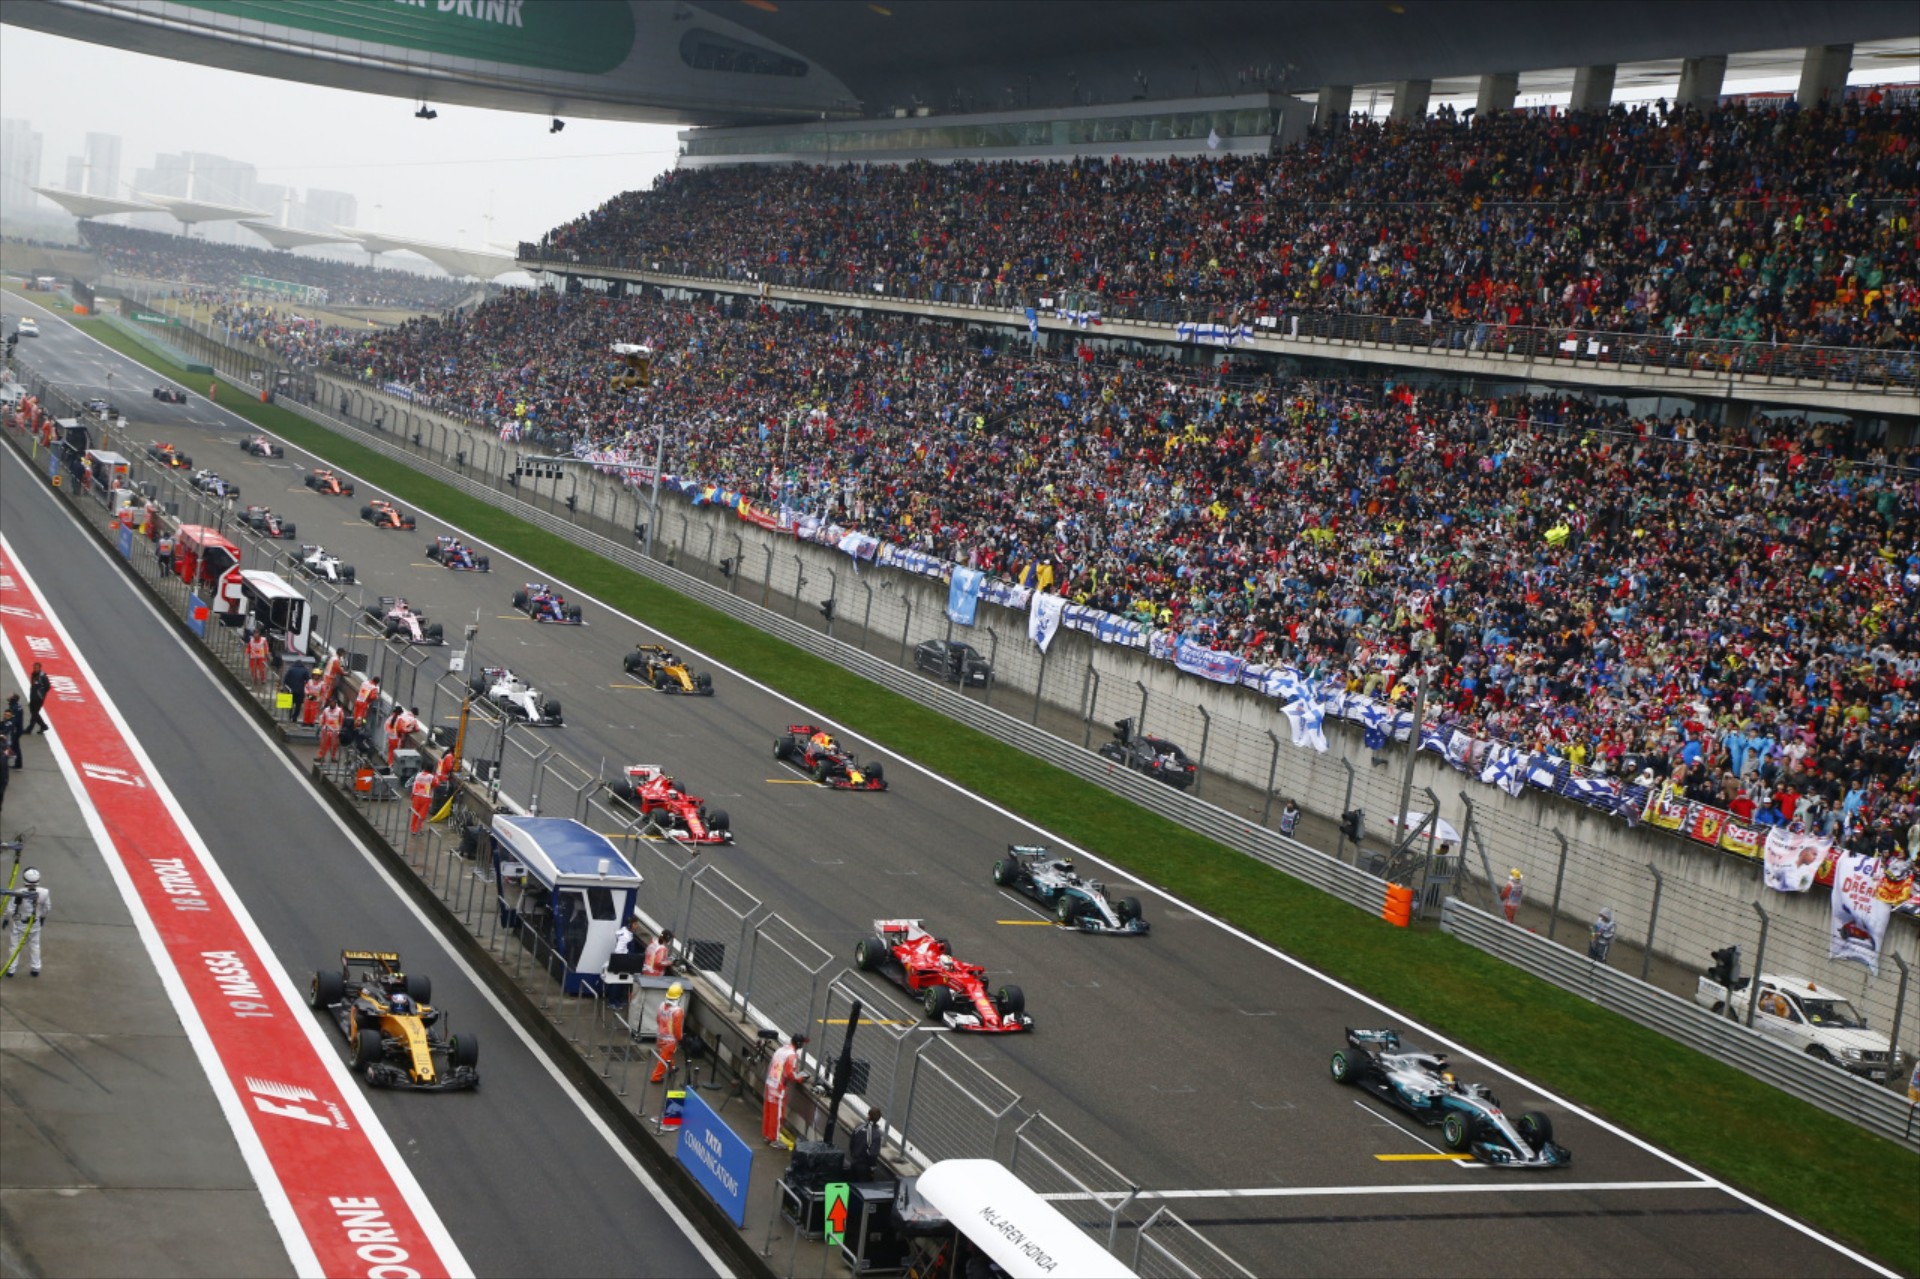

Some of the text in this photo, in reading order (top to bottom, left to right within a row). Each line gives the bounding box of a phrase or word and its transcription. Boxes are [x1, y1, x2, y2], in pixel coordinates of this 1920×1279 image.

[1727, 823, 1758, 846] SEB
[149, 857, 211, 911] 18 STROLL
[200, 951, 274, 1018] 19 MASSA
[684, 1129, 739, 1198] COMMUNICATIONS
[705, 1129, 723, 1158] TATA
[1019, 1241, 1059, 1274] HONDA
